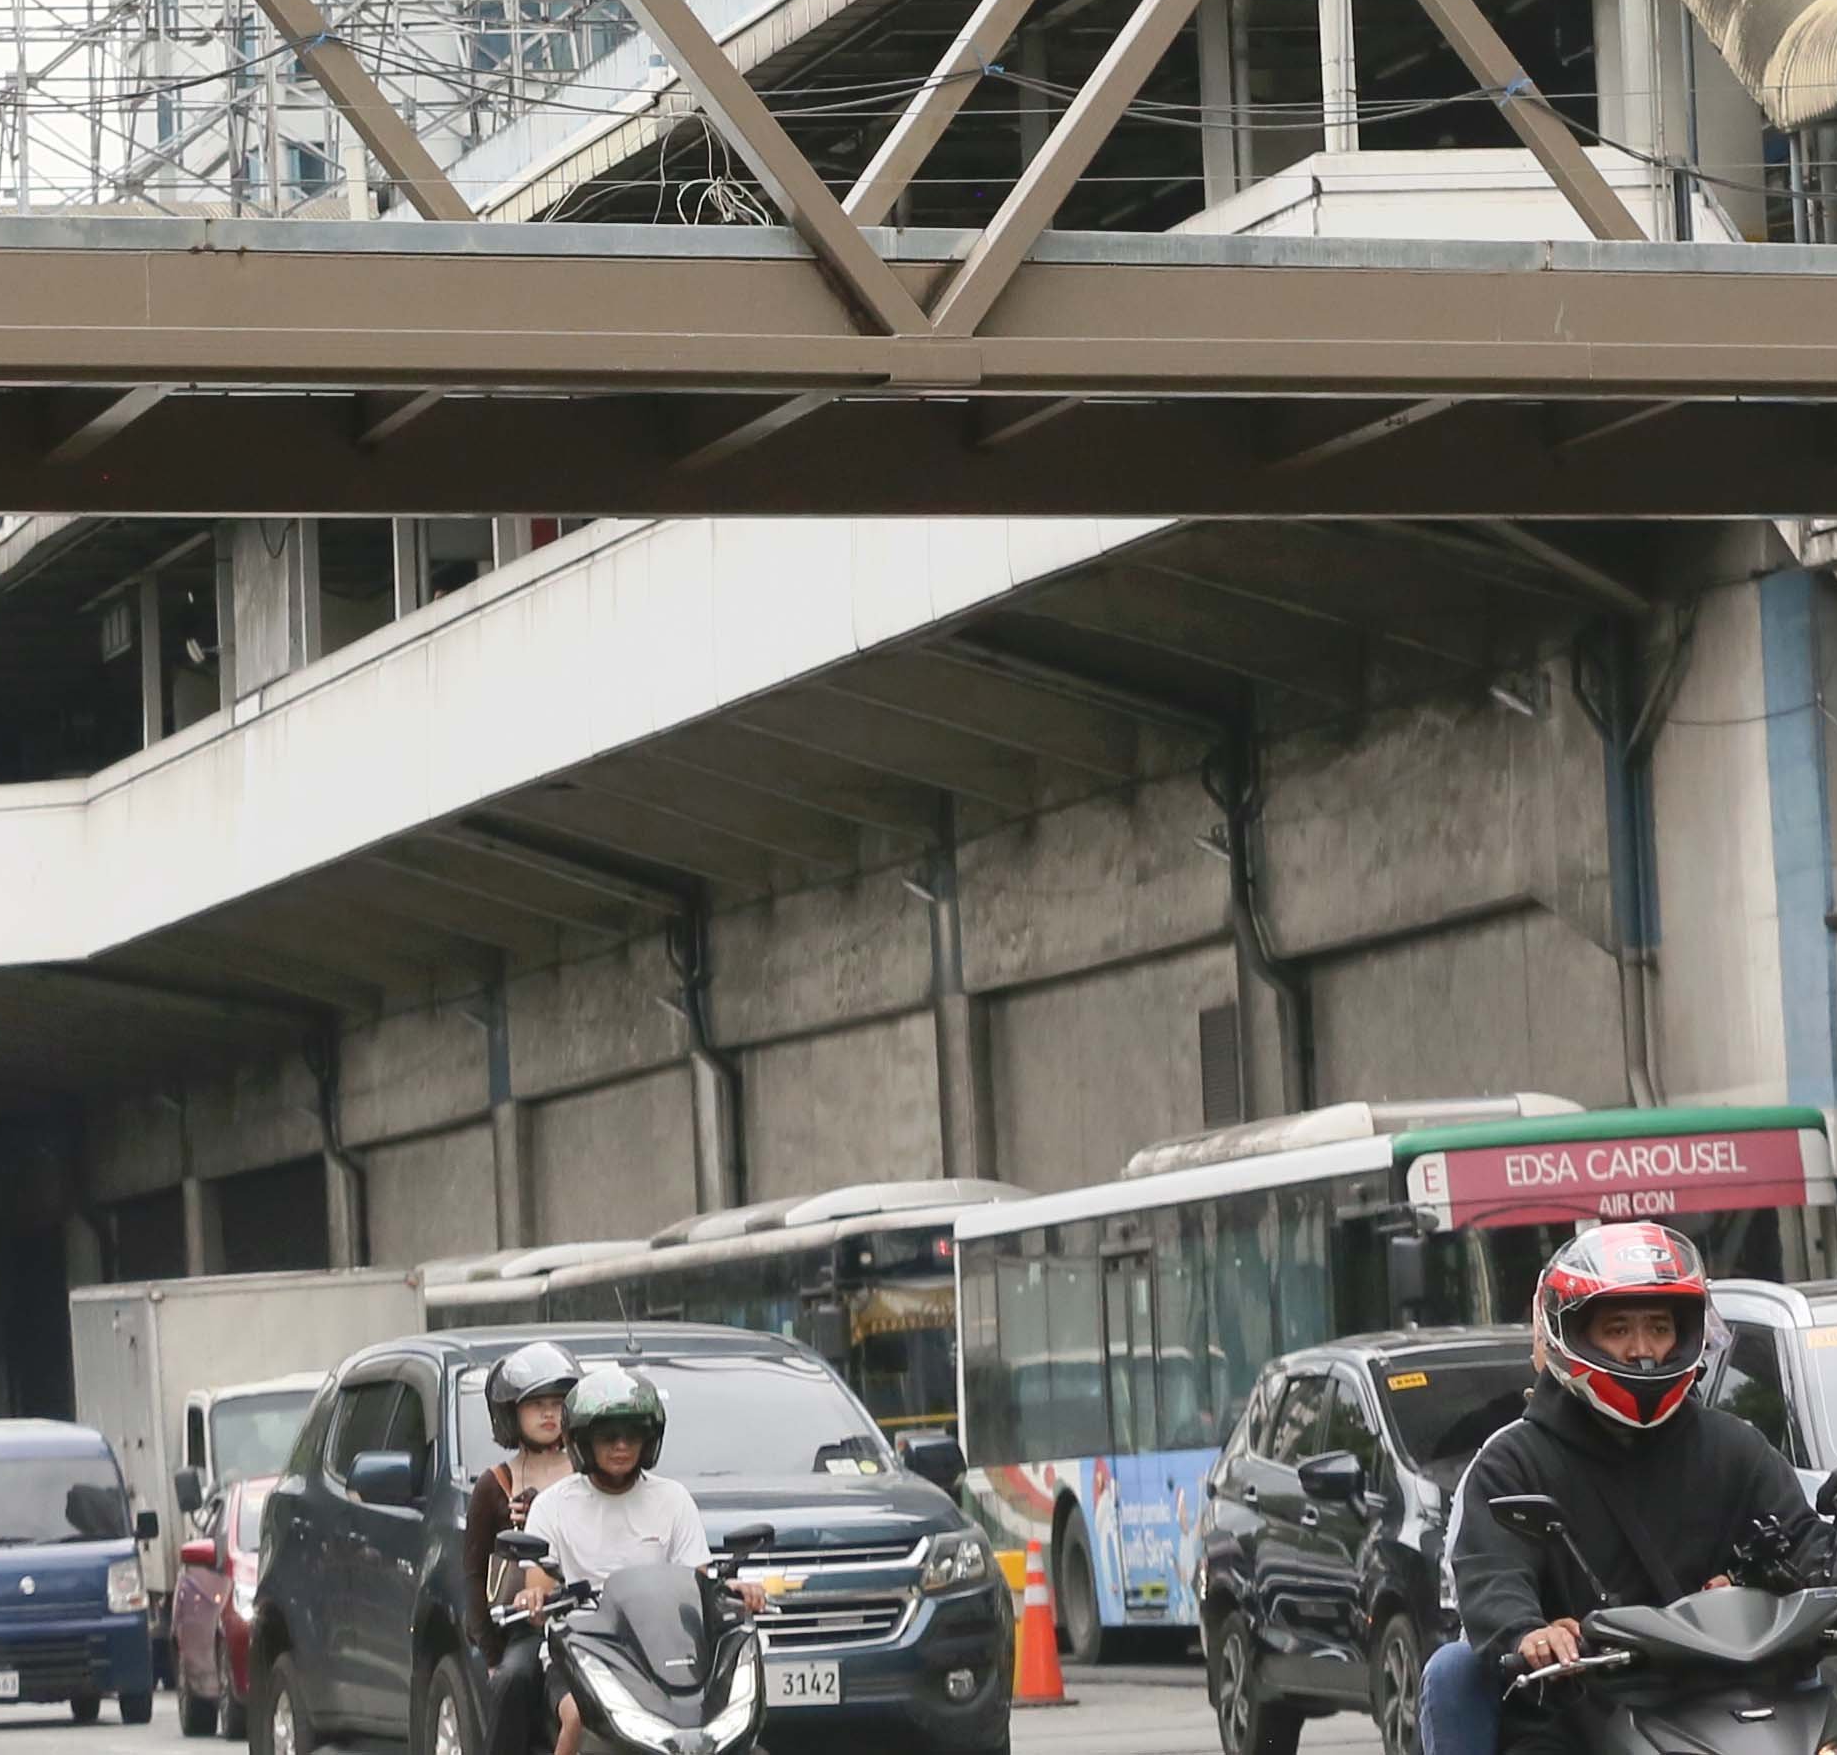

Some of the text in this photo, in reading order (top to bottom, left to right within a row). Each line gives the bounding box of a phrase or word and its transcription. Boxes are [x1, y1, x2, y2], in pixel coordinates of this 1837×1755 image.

[1422, 1163, 1440, 1194] E
[1505, 1141, 1748, 1187] EDSA CAROUSEL
[782, 1671, 836, 1696] 3142
